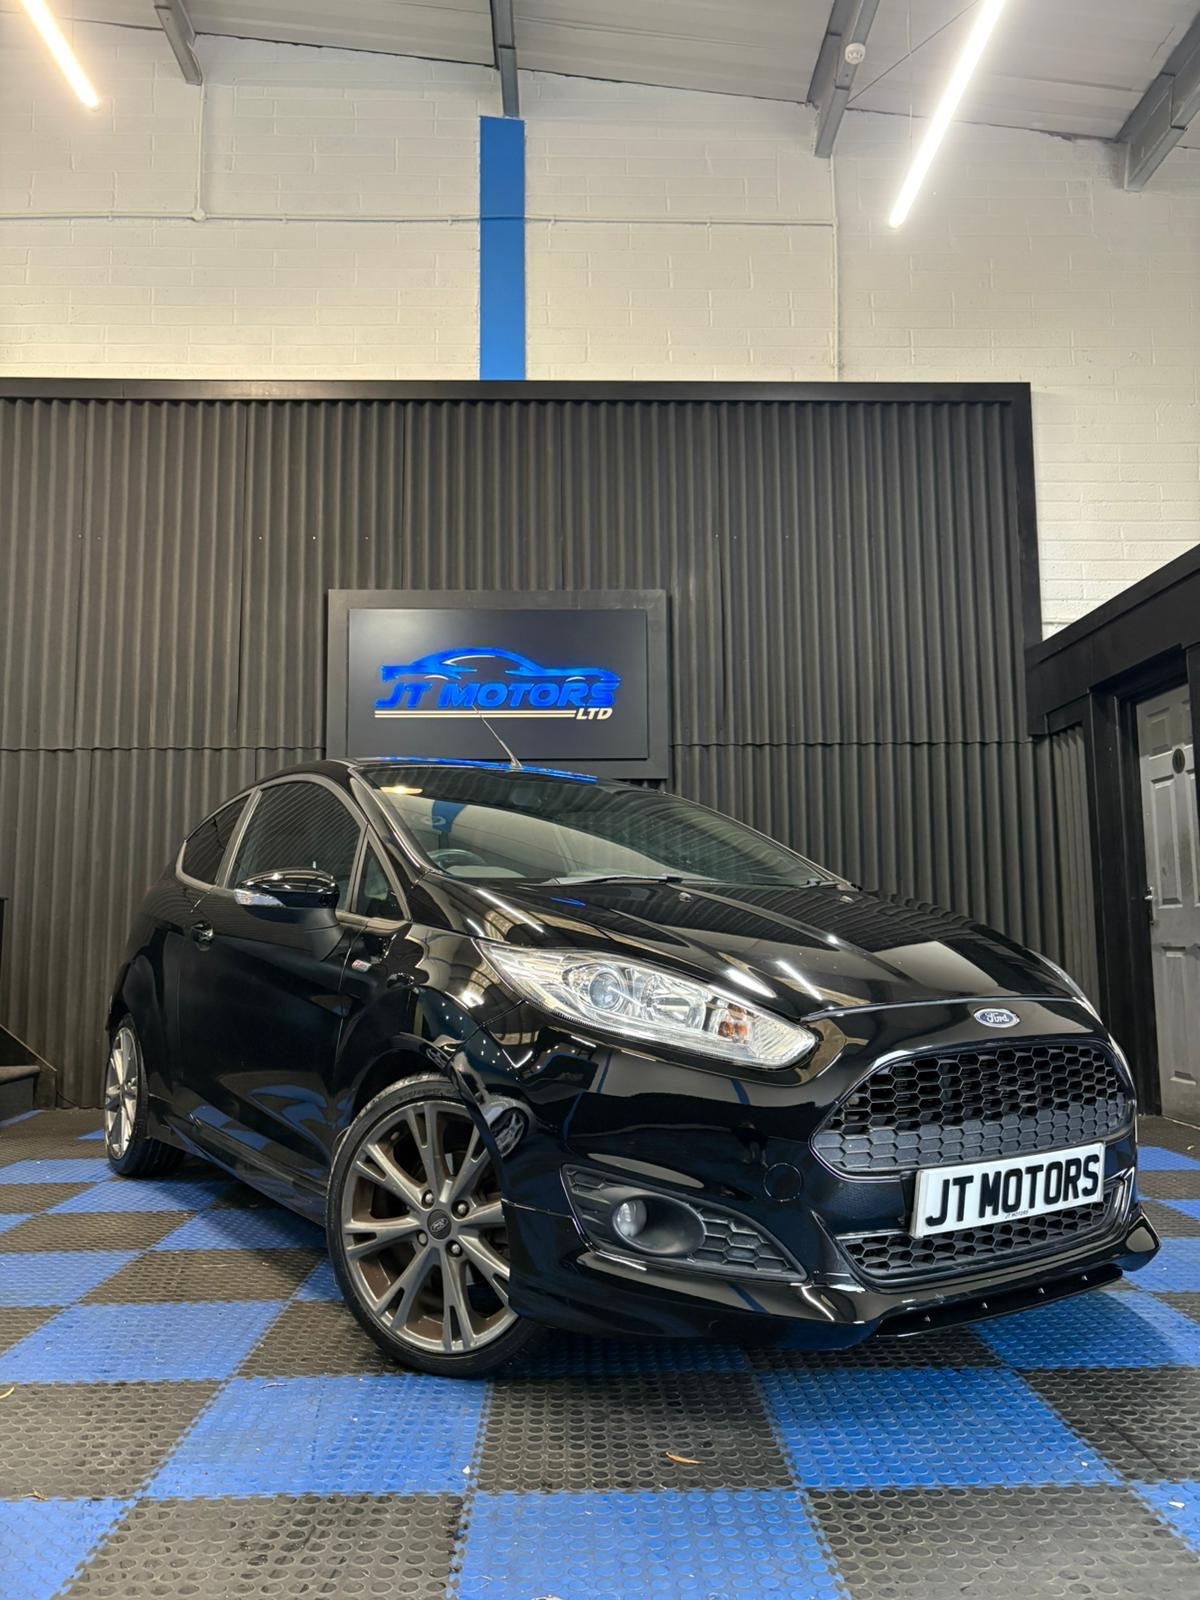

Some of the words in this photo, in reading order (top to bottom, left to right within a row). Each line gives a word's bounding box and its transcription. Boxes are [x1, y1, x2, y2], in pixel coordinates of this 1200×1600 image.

[375, 683, 432, 708] JT
[438, 683, 619, 708] MOTORS
[576, 707, 613, 720] LTD
[982, 1010, 1010, 1023] Ford
[925, 1175, 973, 1226] JT
[978, 1154, 1100, 1218] MOTORS
